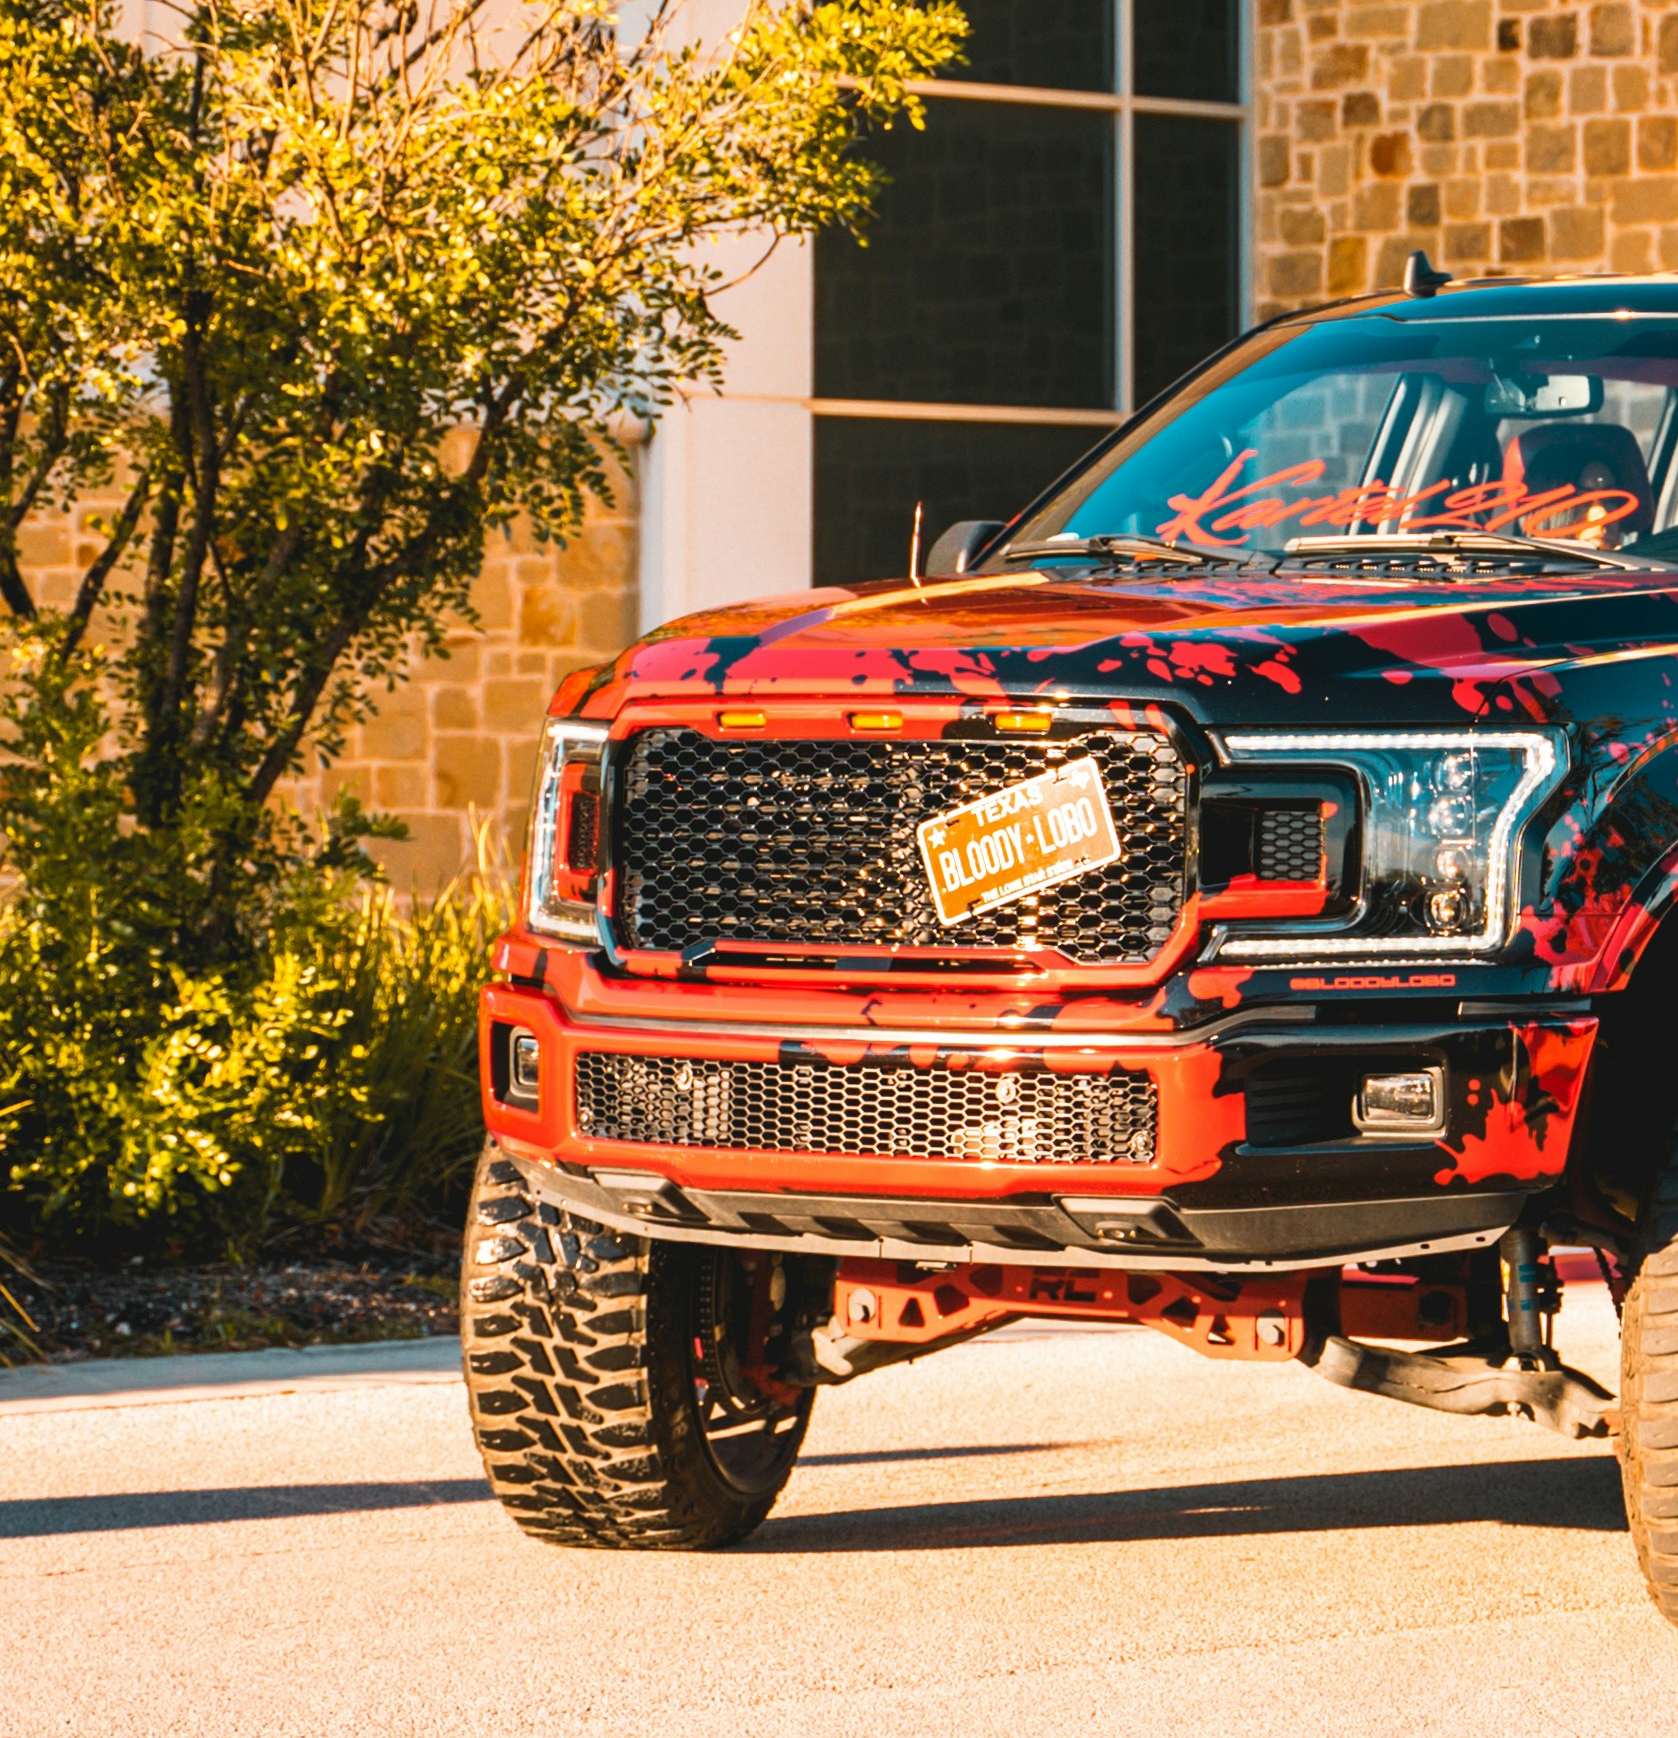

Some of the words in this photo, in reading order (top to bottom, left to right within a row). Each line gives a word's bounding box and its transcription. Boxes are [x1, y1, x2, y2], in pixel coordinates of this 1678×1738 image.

[971, 784, 1044, 827] TEXAS
[938, 822, 1026, 892] BLOODY
[1032, 797, 1098, 855] LOBO
[981, 887, 1000, 903] THE
[999, 878, 1023, 896] LONE
[1023, 867, 1046, 887] STAR
